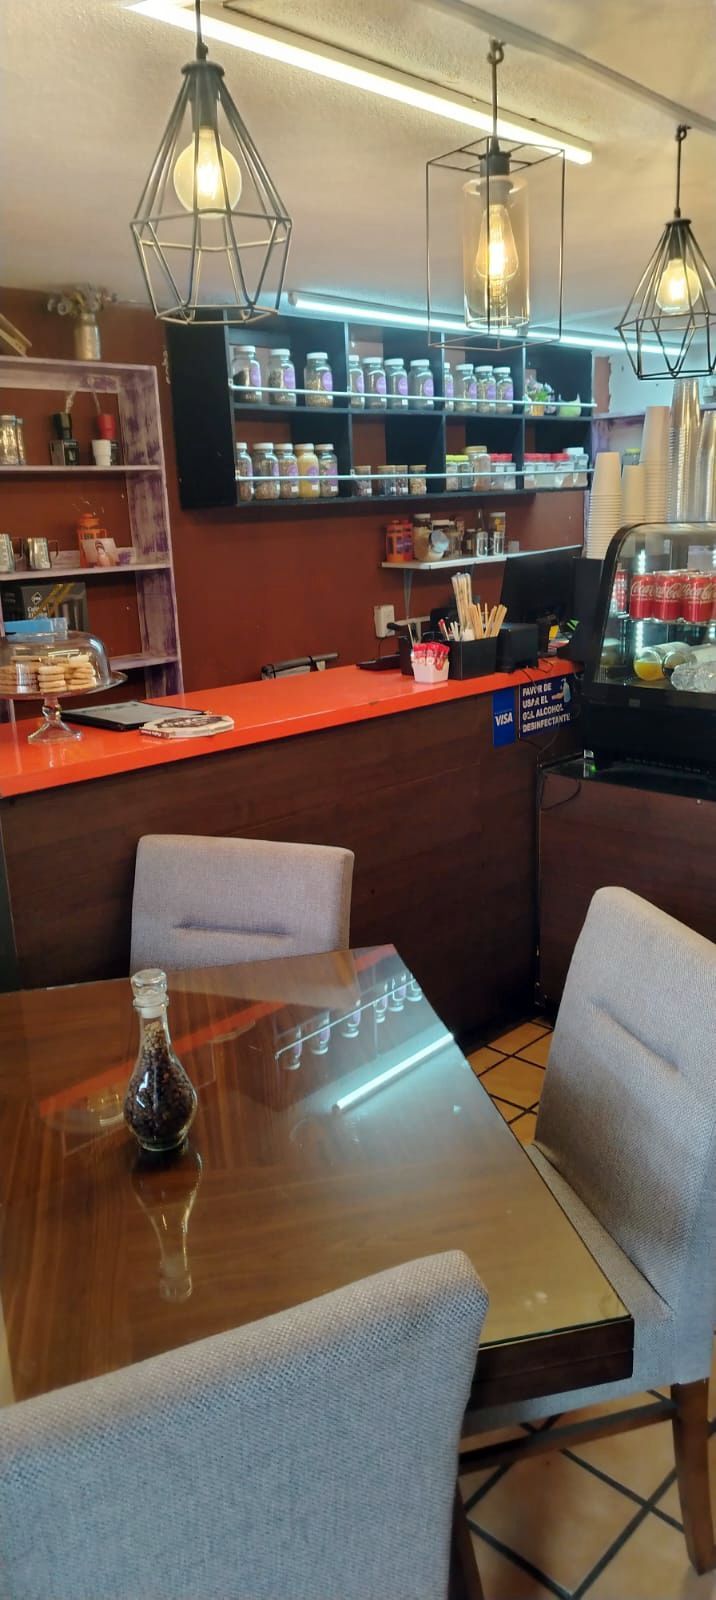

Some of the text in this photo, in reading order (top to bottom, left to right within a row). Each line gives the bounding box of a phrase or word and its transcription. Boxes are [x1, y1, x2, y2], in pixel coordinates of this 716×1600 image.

[522, 683, 552, 697] FAVOR DE
[540, 696, 549, 705] EL
[536, 704, 564, 718] ALCOHOL
[495, 712, 513, 727] VISA
[522, 714, 571, 733] DESINFECTANTE
